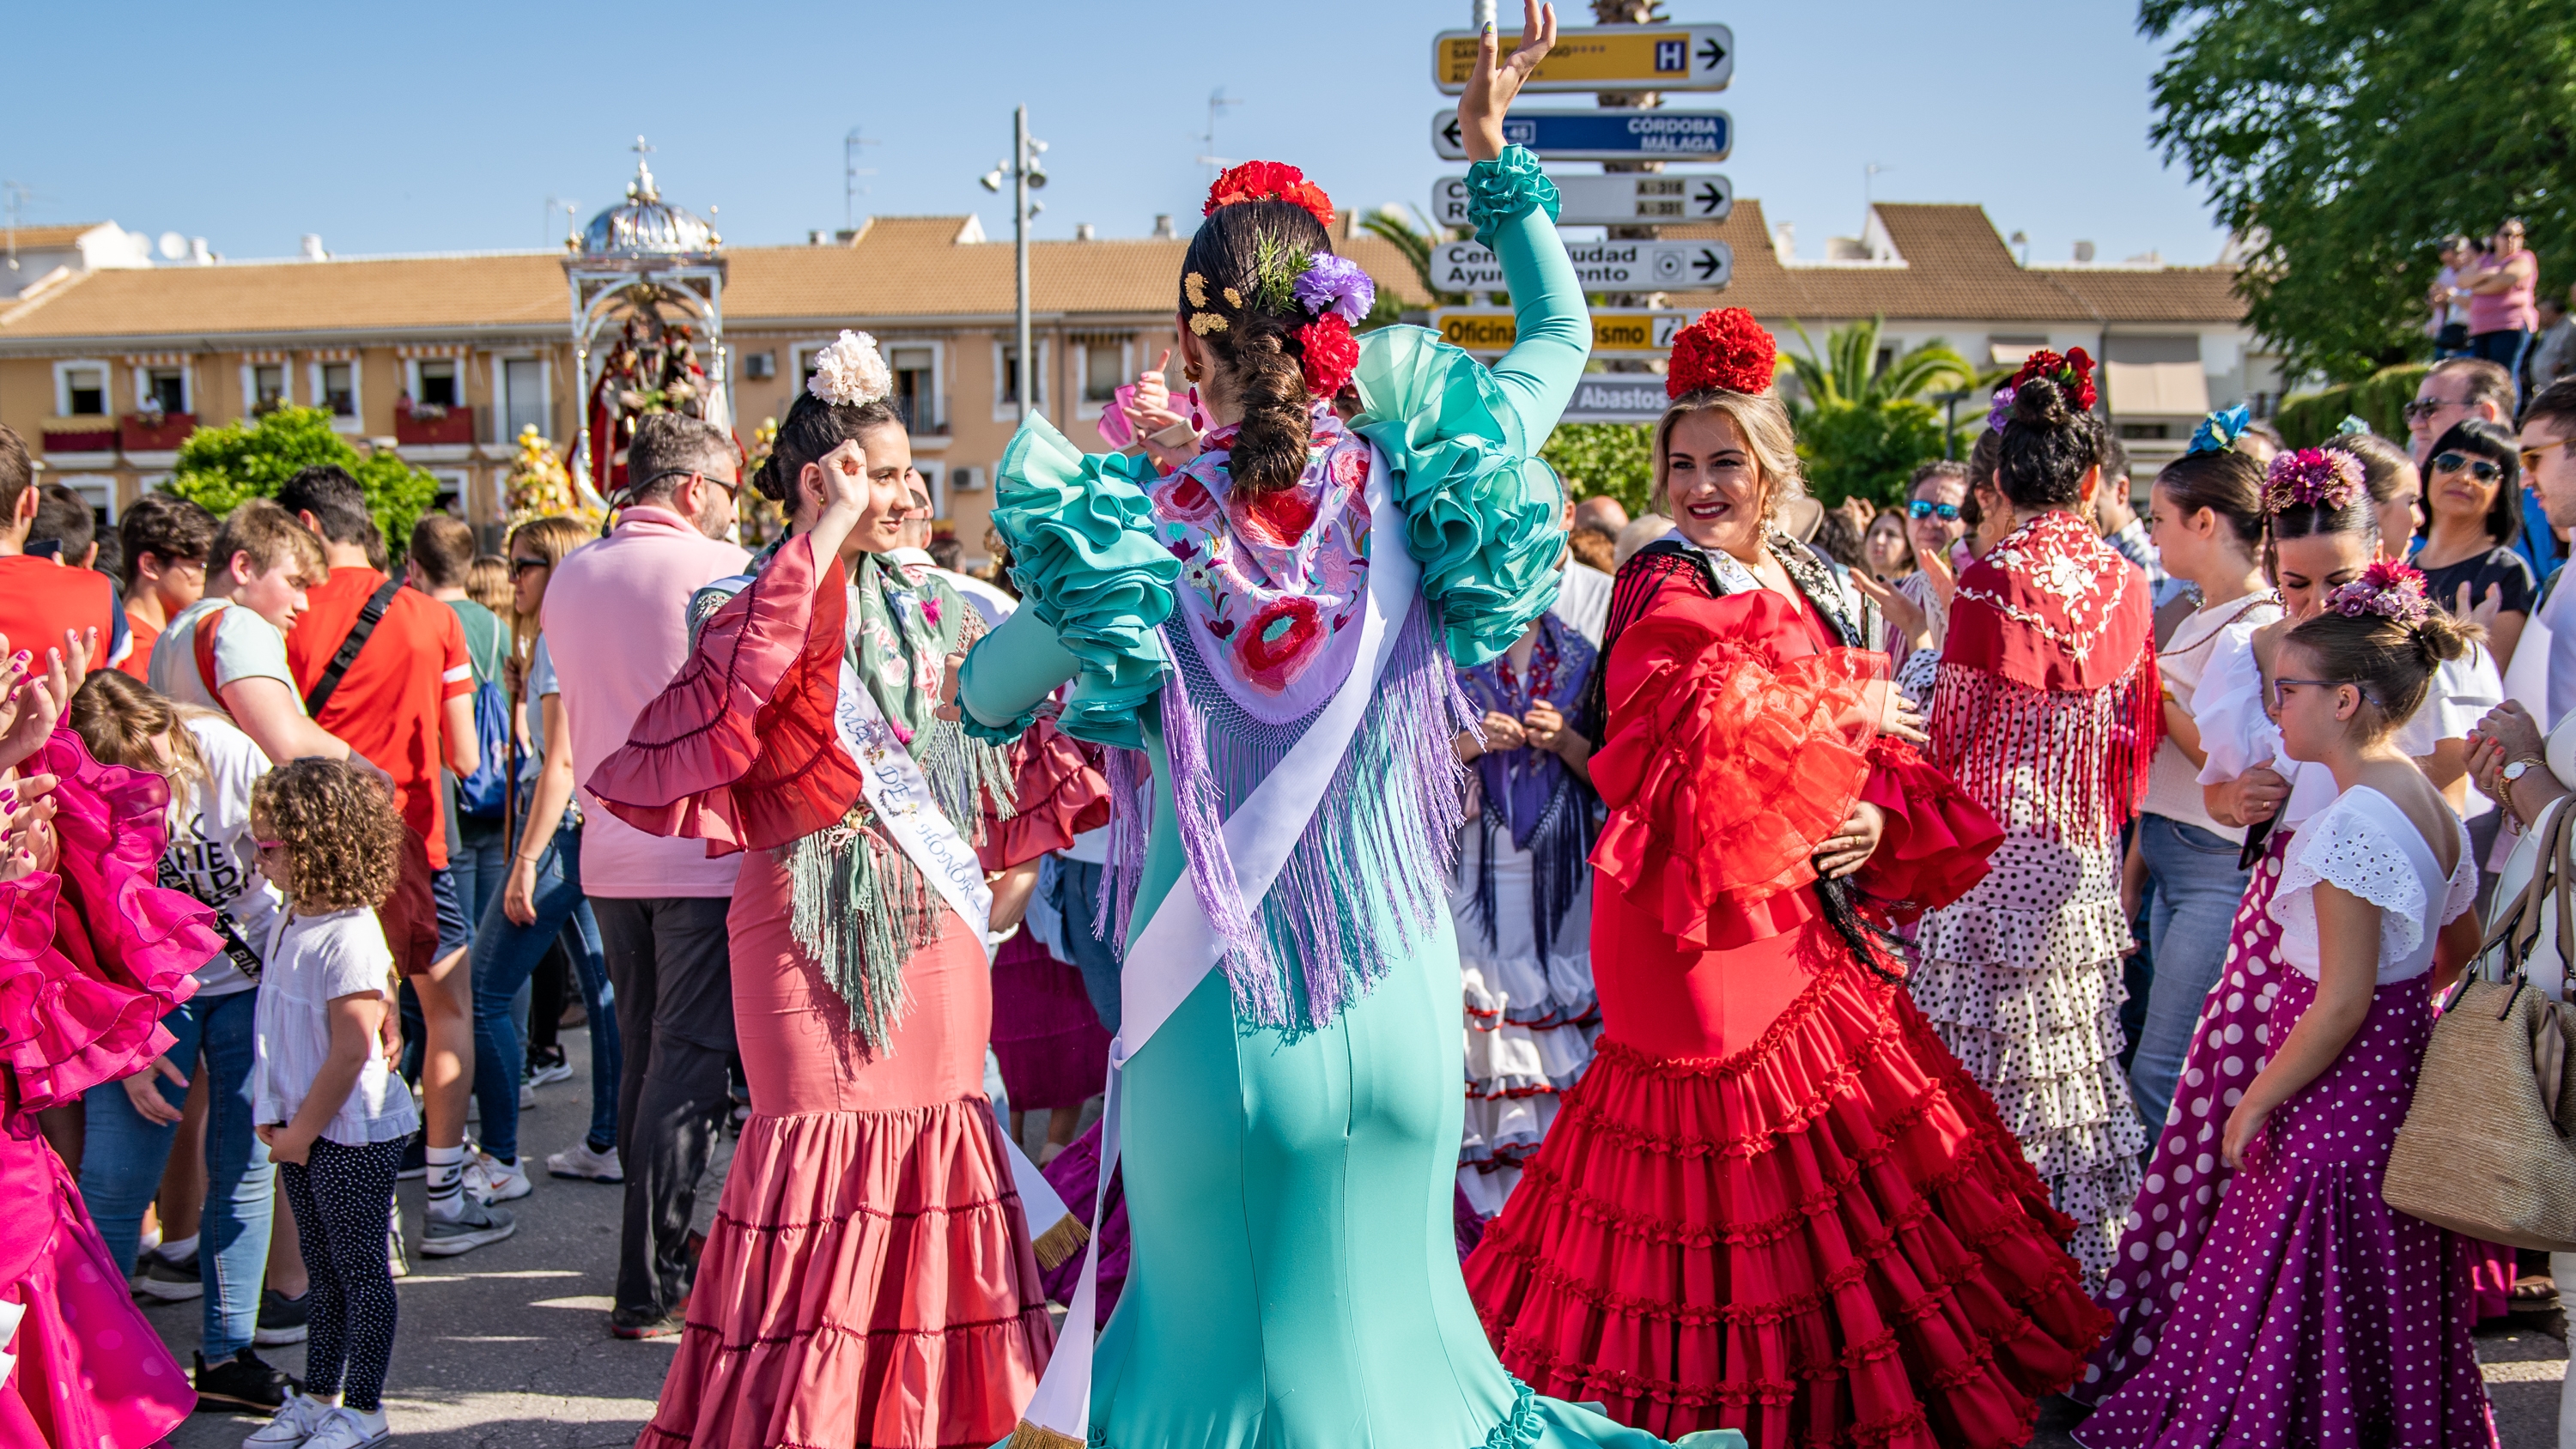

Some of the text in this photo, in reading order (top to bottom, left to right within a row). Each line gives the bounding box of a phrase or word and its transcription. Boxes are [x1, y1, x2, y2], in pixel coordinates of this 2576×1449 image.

[1627, 117, 1718, 134] CÓRDOBA
[1640, 134, 1717, 152] MÁLAGA
[1448, 246, 1637, 264] Cen udad
[1593, 321, 1644, 343] ismo
[1578, 386, 1668, 409] Abastos
[875, 765, 911, 802] DE
[915, 823, 975, 903] HONOR
[229, 949, 262, 981] BIM
